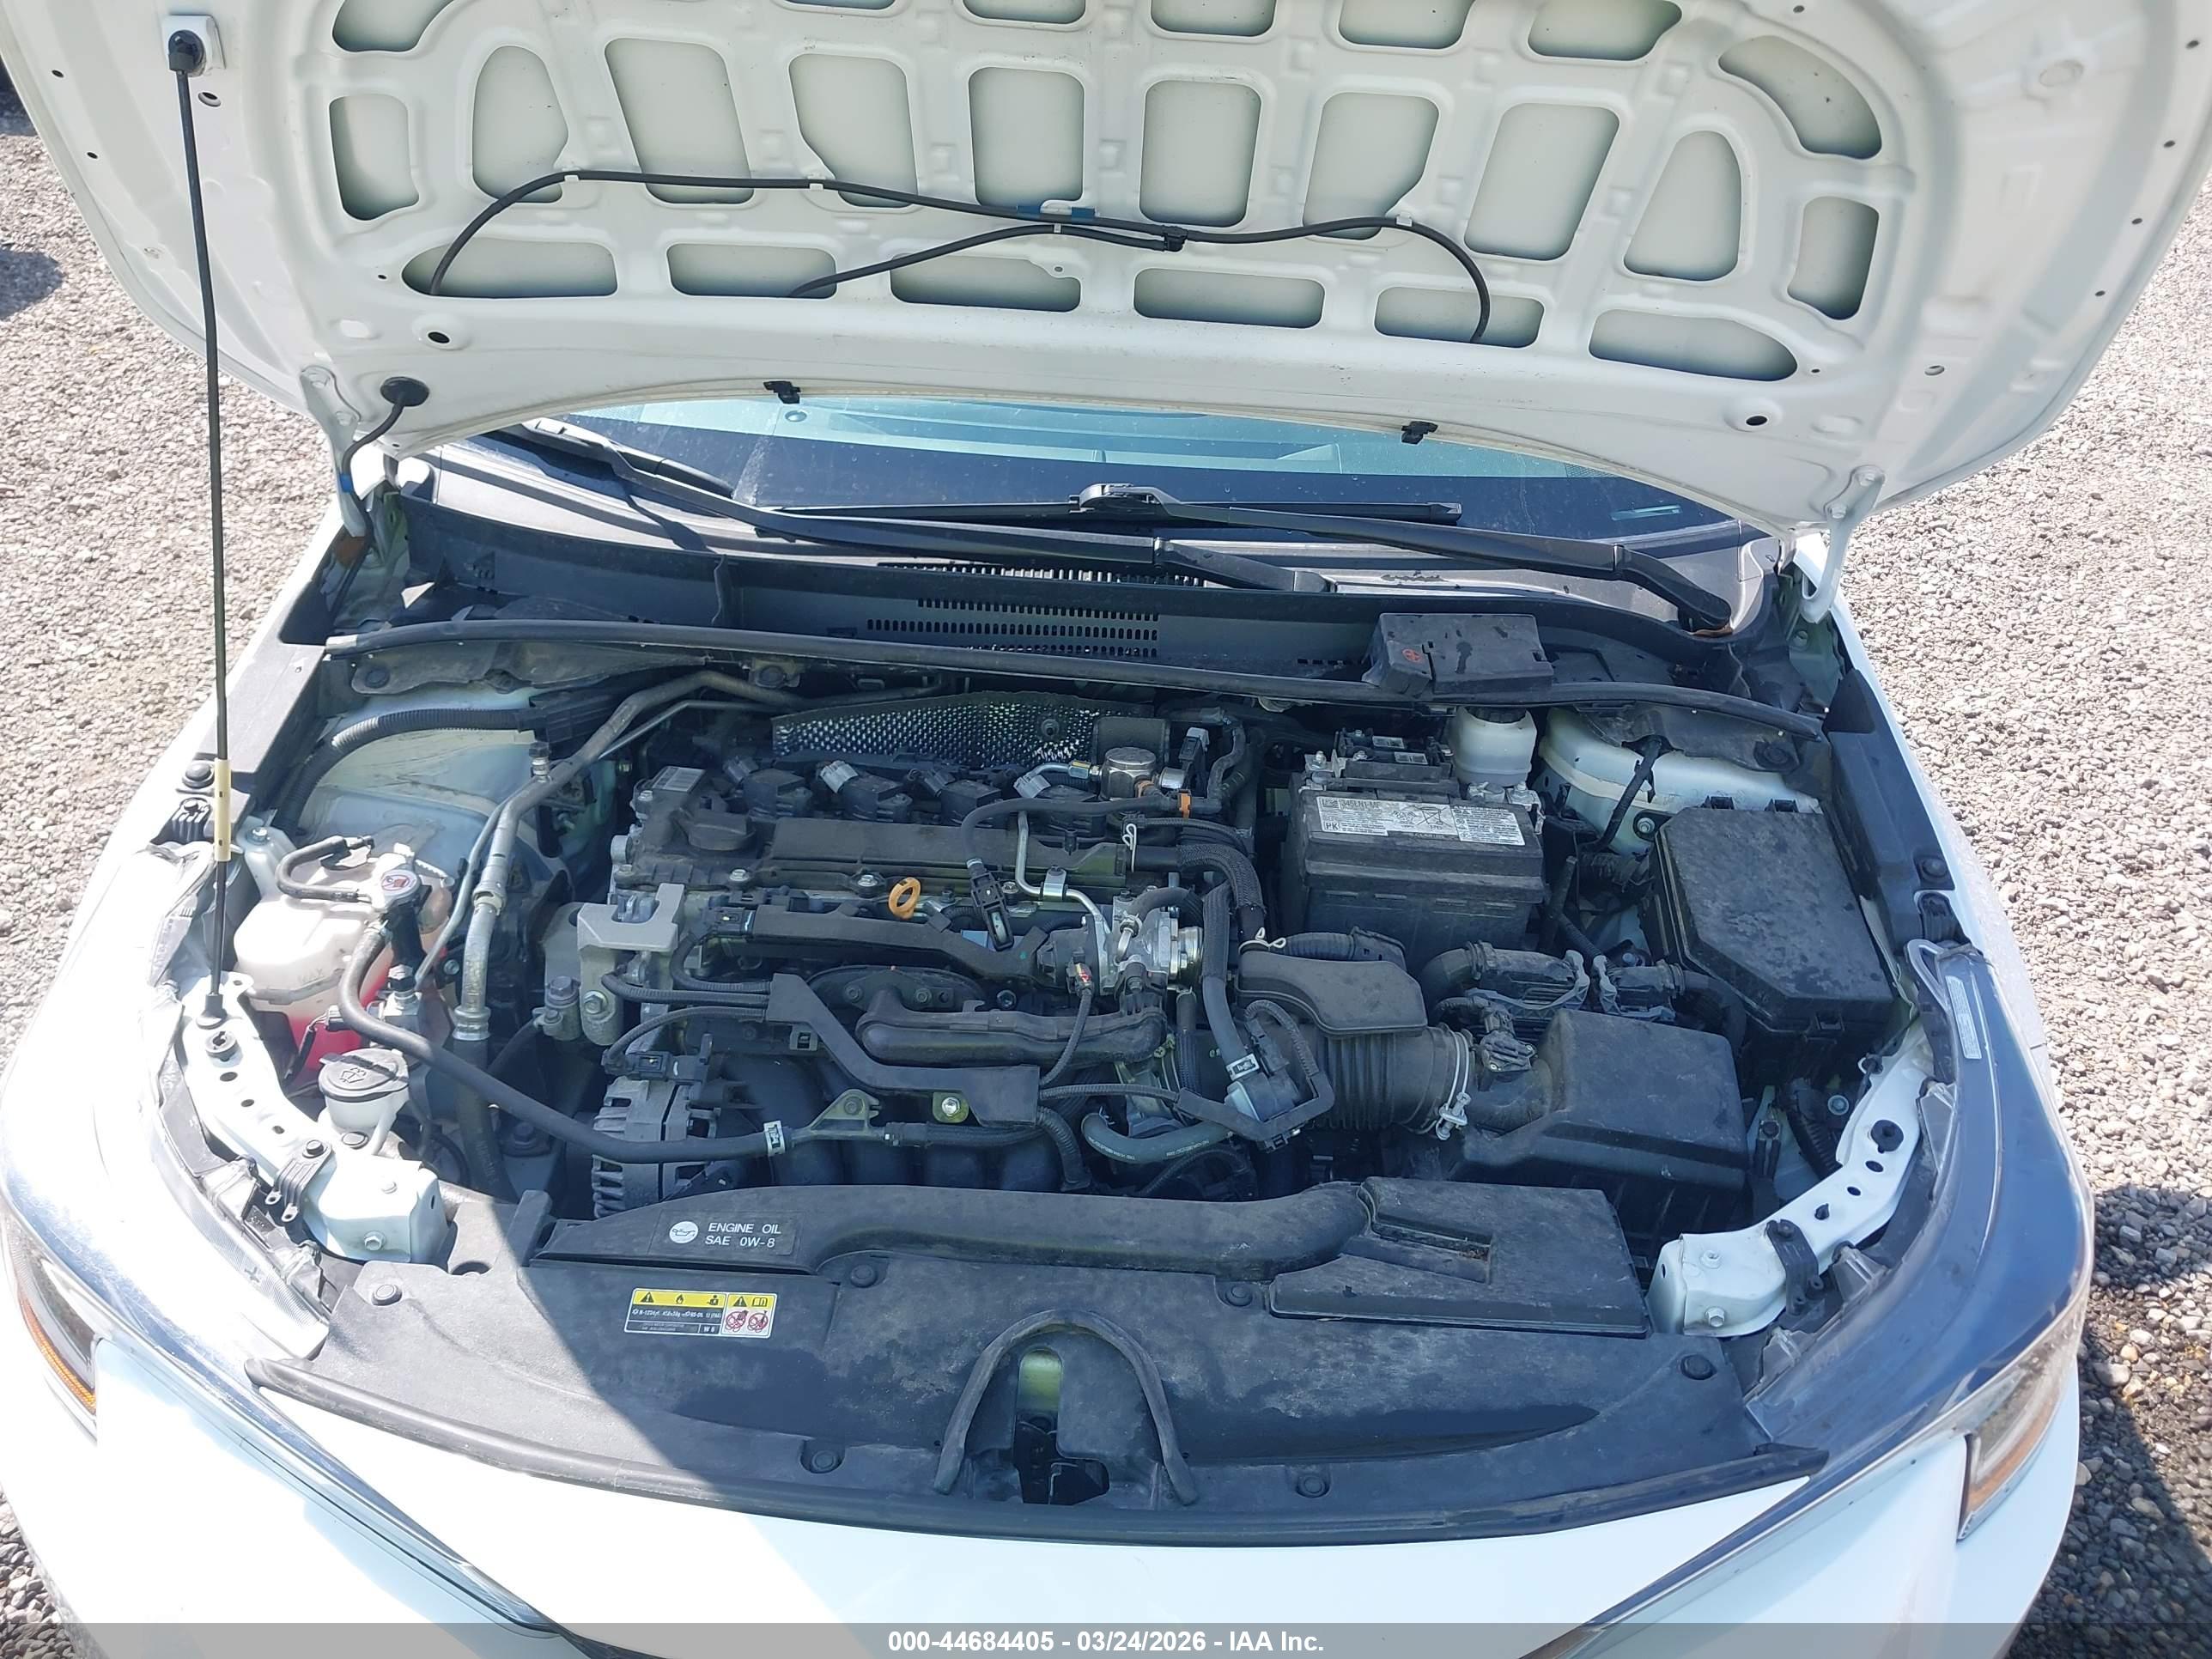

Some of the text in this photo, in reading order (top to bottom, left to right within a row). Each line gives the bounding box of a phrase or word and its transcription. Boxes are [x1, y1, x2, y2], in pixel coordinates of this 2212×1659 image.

[708, 1222, 781, 1235] ENGINE OIL
[705, 1235, 775, 1248] SAE 0W-8
